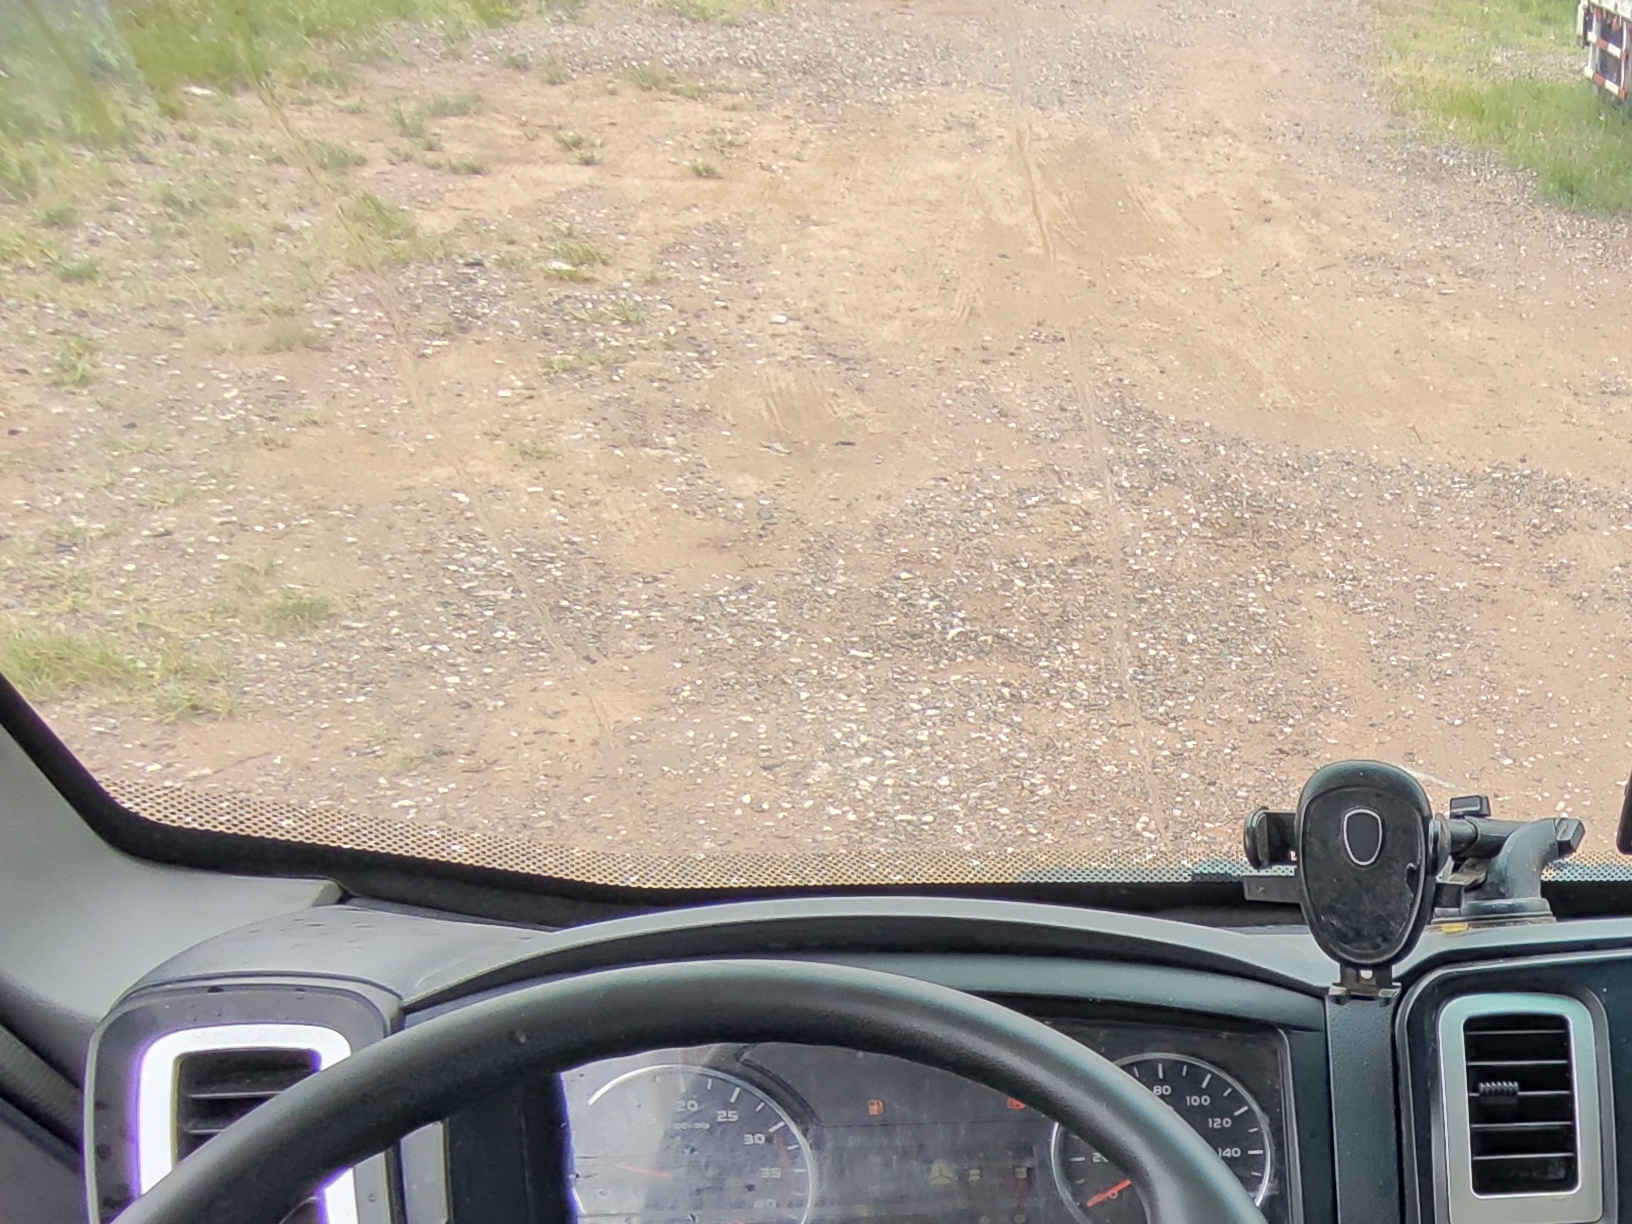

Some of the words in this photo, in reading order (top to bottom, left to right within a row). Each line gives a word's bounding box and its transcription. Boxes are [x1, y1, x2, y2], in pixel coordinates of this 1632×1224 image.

[1153, 1085, 1172, 1096] 80
[677, 1101, 699, 1112] 20
[1186, 1096, 1210, 1106] 100
[717, 1110, 739, 1122] 25
[1208, 1118, 1232, 1128] 120
[743, 1133, 765, 1144] 30
[1092, 1152, 1109, 1163] 2
[1218, 1148, 1241, 1158] 140
[760, 1168, 781, 1179] 35
